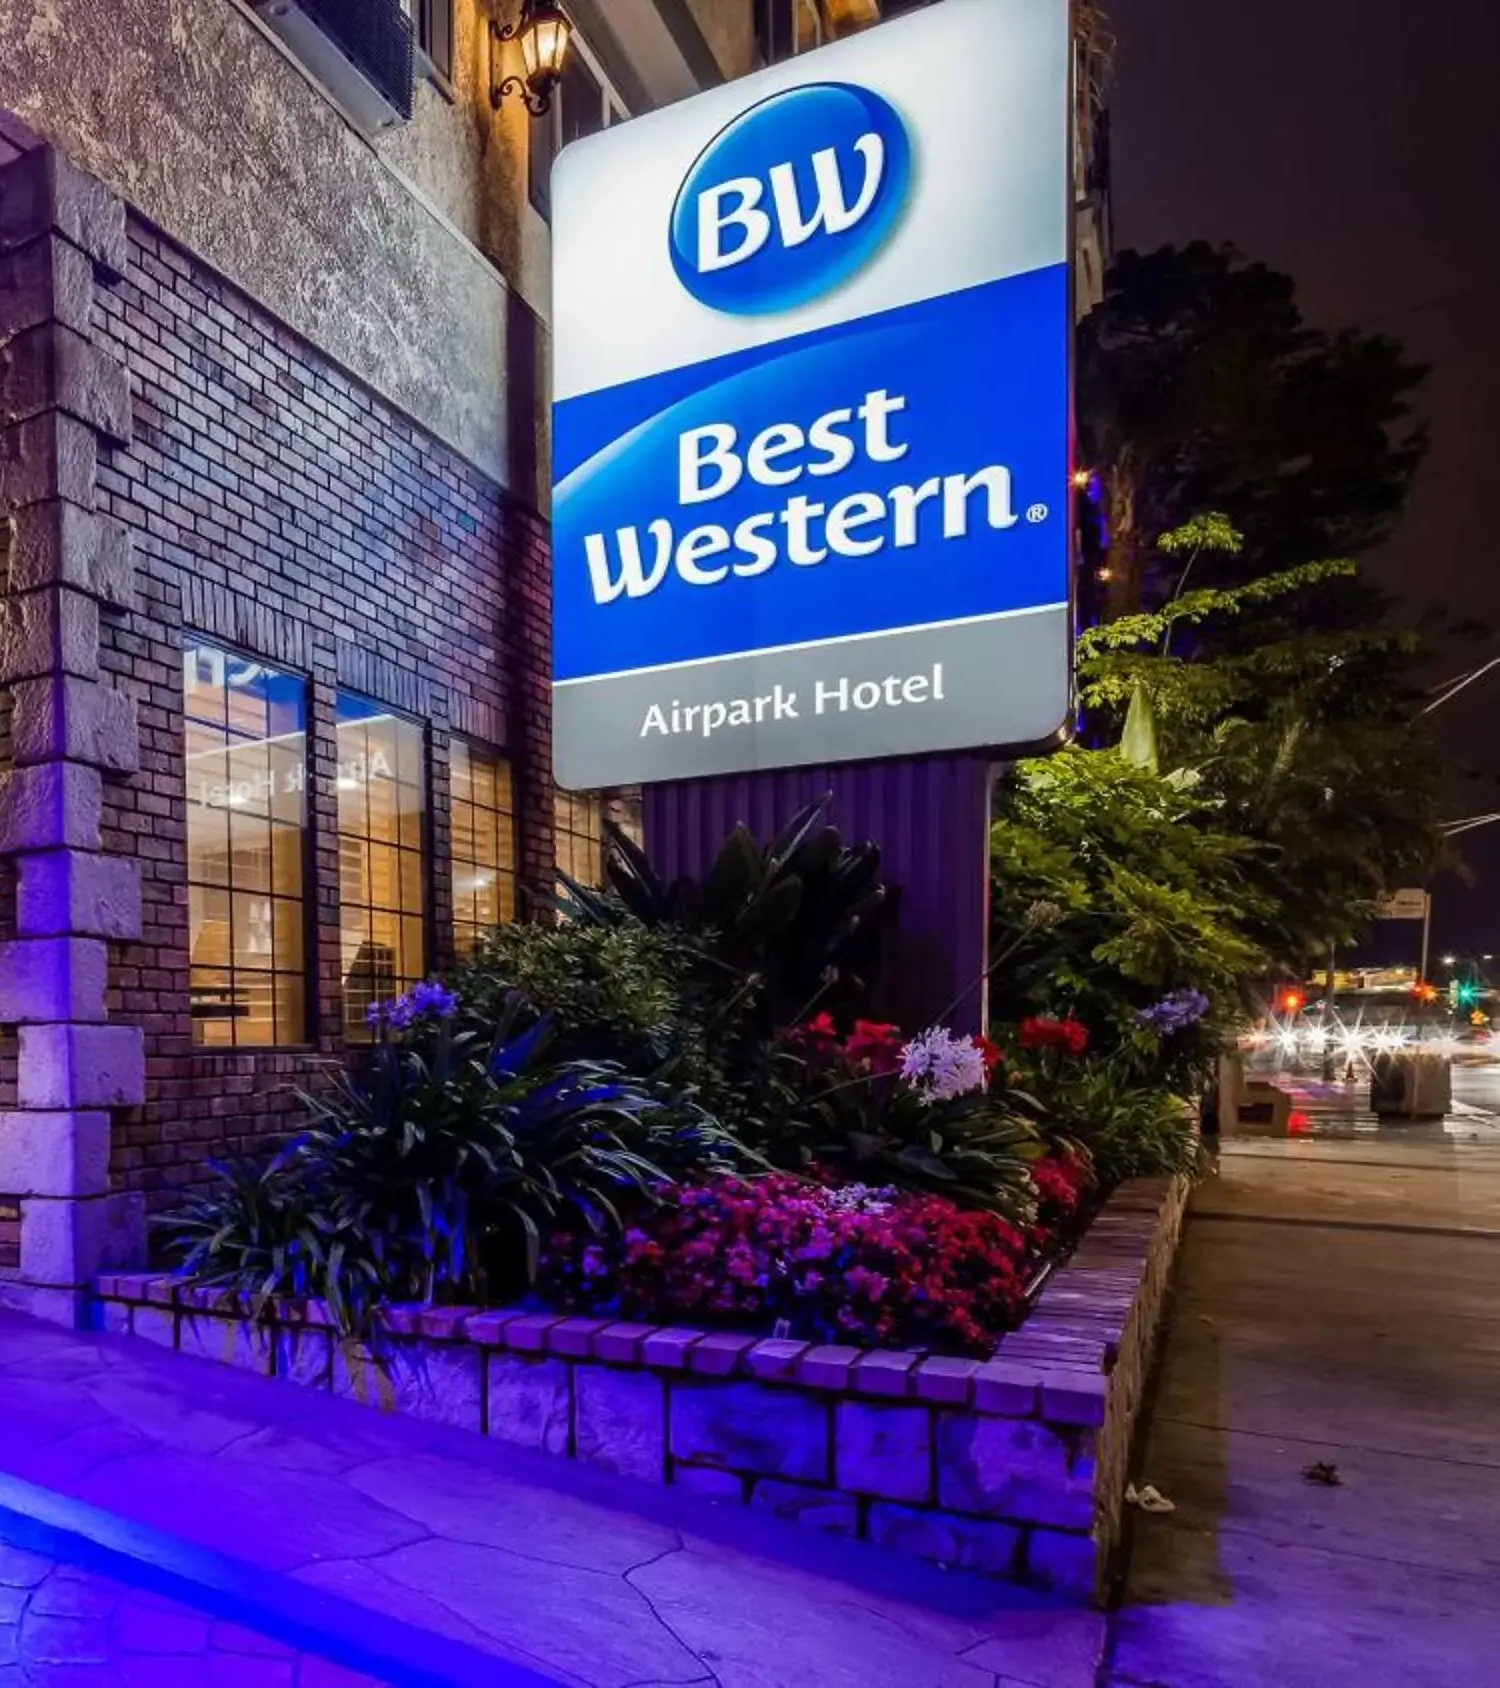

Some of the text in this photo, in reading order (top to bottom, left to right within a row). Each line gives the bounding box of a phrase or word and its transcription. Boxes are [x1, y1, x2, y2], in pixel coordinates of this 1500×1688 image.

[697, 132, 884, 273] BW
[679, 389, 908, 505] Best
[640, 663, 944, 737] Airpark Hotel
